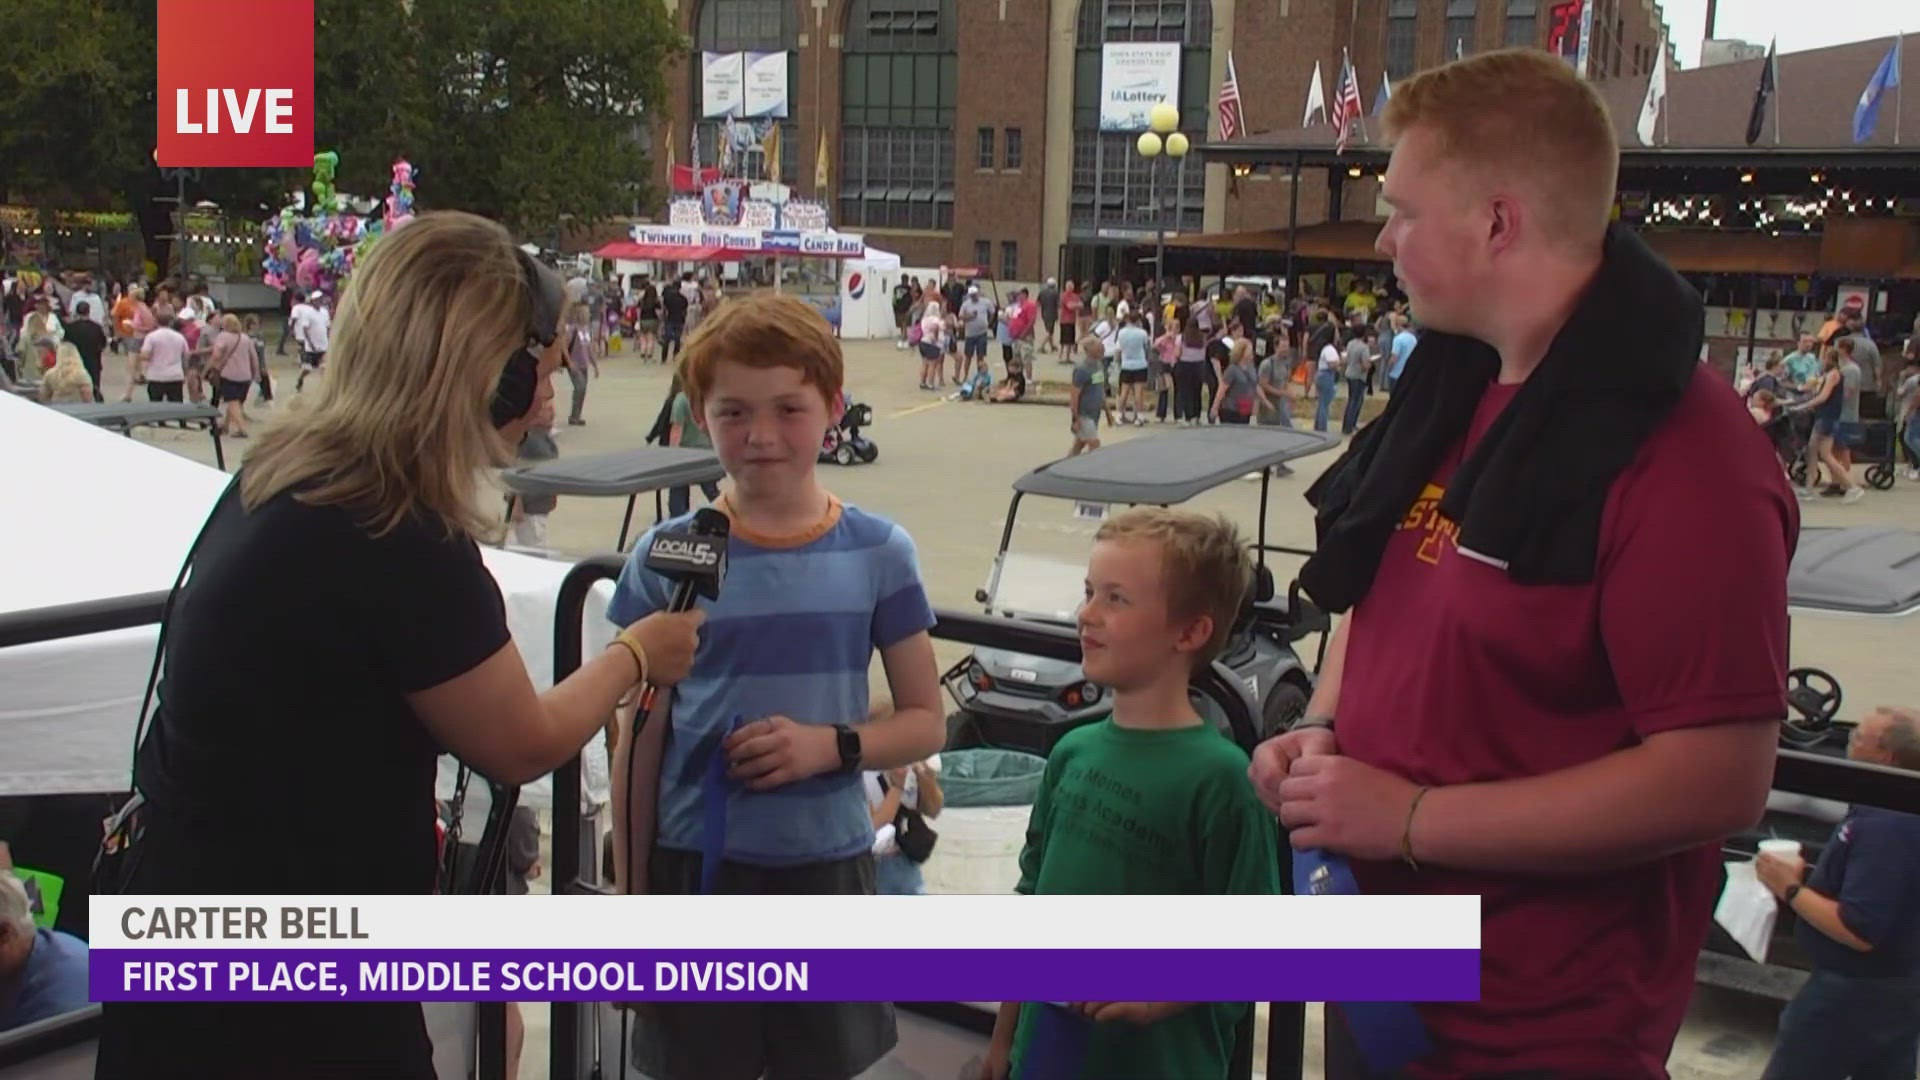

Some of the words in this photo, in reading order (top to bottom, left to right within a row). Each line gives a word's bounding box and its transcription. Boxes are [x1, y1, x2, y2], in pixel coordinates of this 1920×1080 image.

[640, 230, 692, 246] TWINKIES
[723, 233, 757, 249] COOKIES
[804, 237, 835, 251] CANDY
[837, 239, 859, 252] BARS
